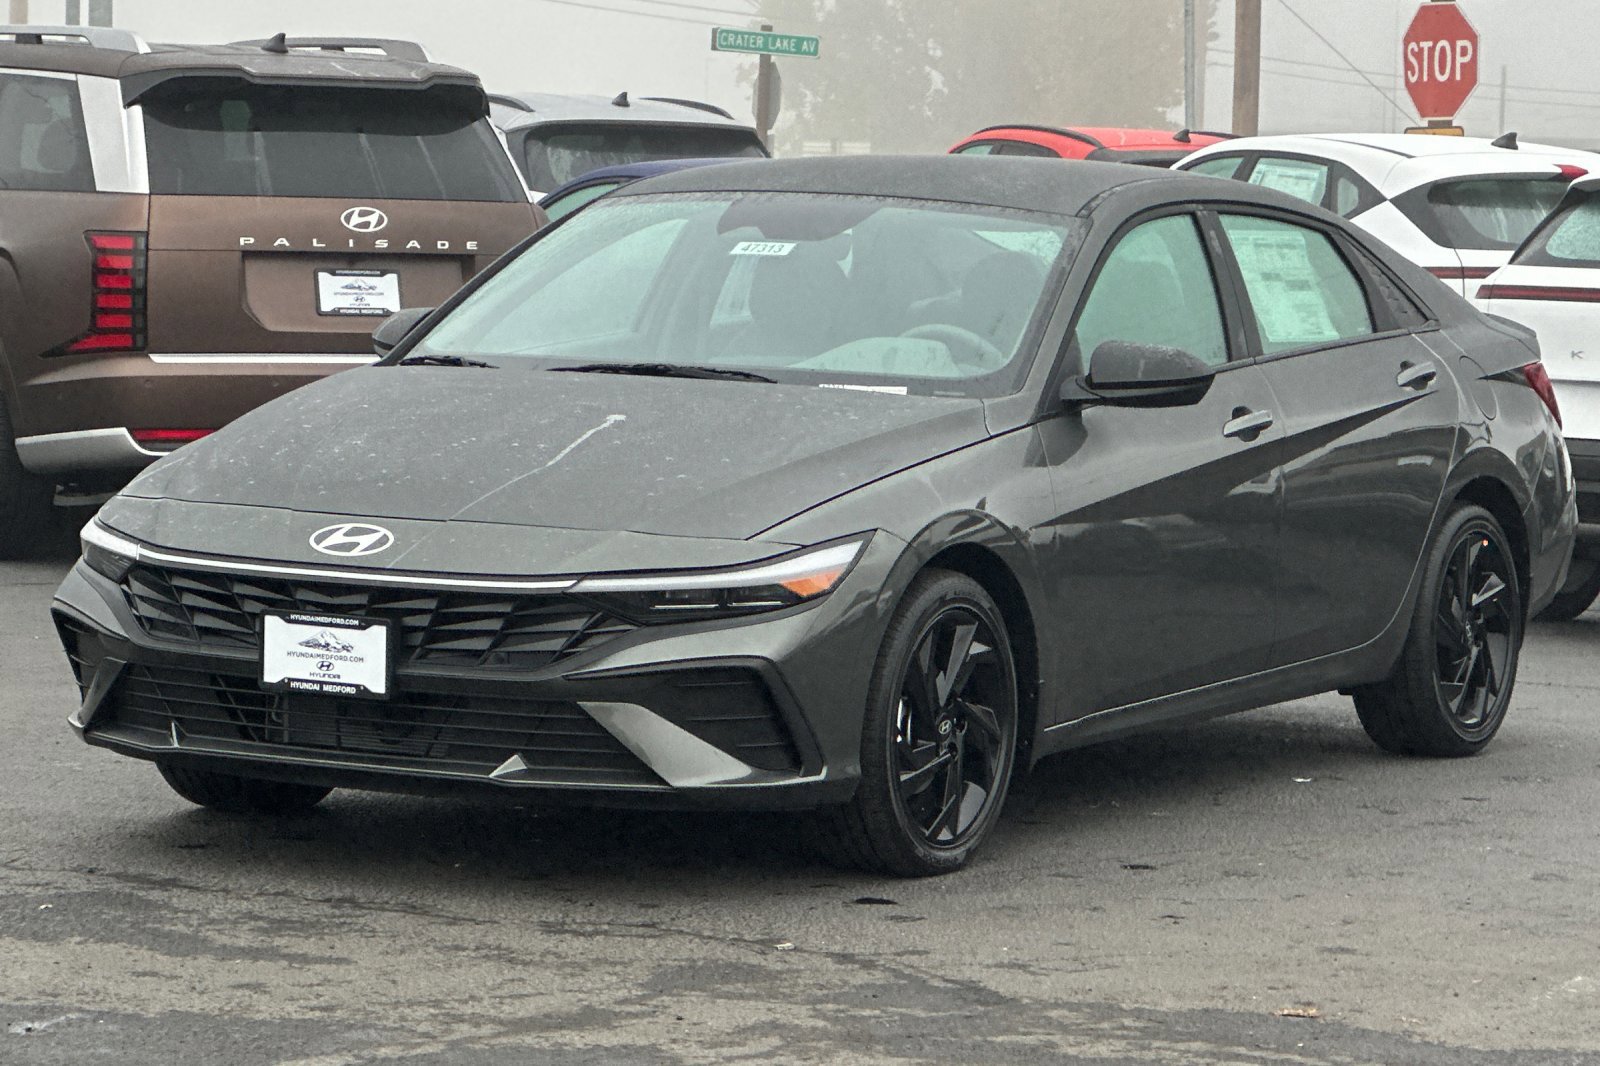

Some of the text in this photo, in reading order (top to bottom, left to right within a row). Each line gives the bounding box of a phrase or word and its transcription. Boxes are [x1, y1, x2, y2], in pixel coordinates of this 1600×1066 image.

[720, 33, 816, 52] CRATER LAKE AV
[1407, 39, 1473, 83] STOP
[239, 237, 478, 250] PALISADE
[741, 243, 784, 253] 47313
[287, 651, 364, 662] HYUNDAIMEDFORD.COM
[290, 681, 356, 694] HYUNDAI MEDFORD
